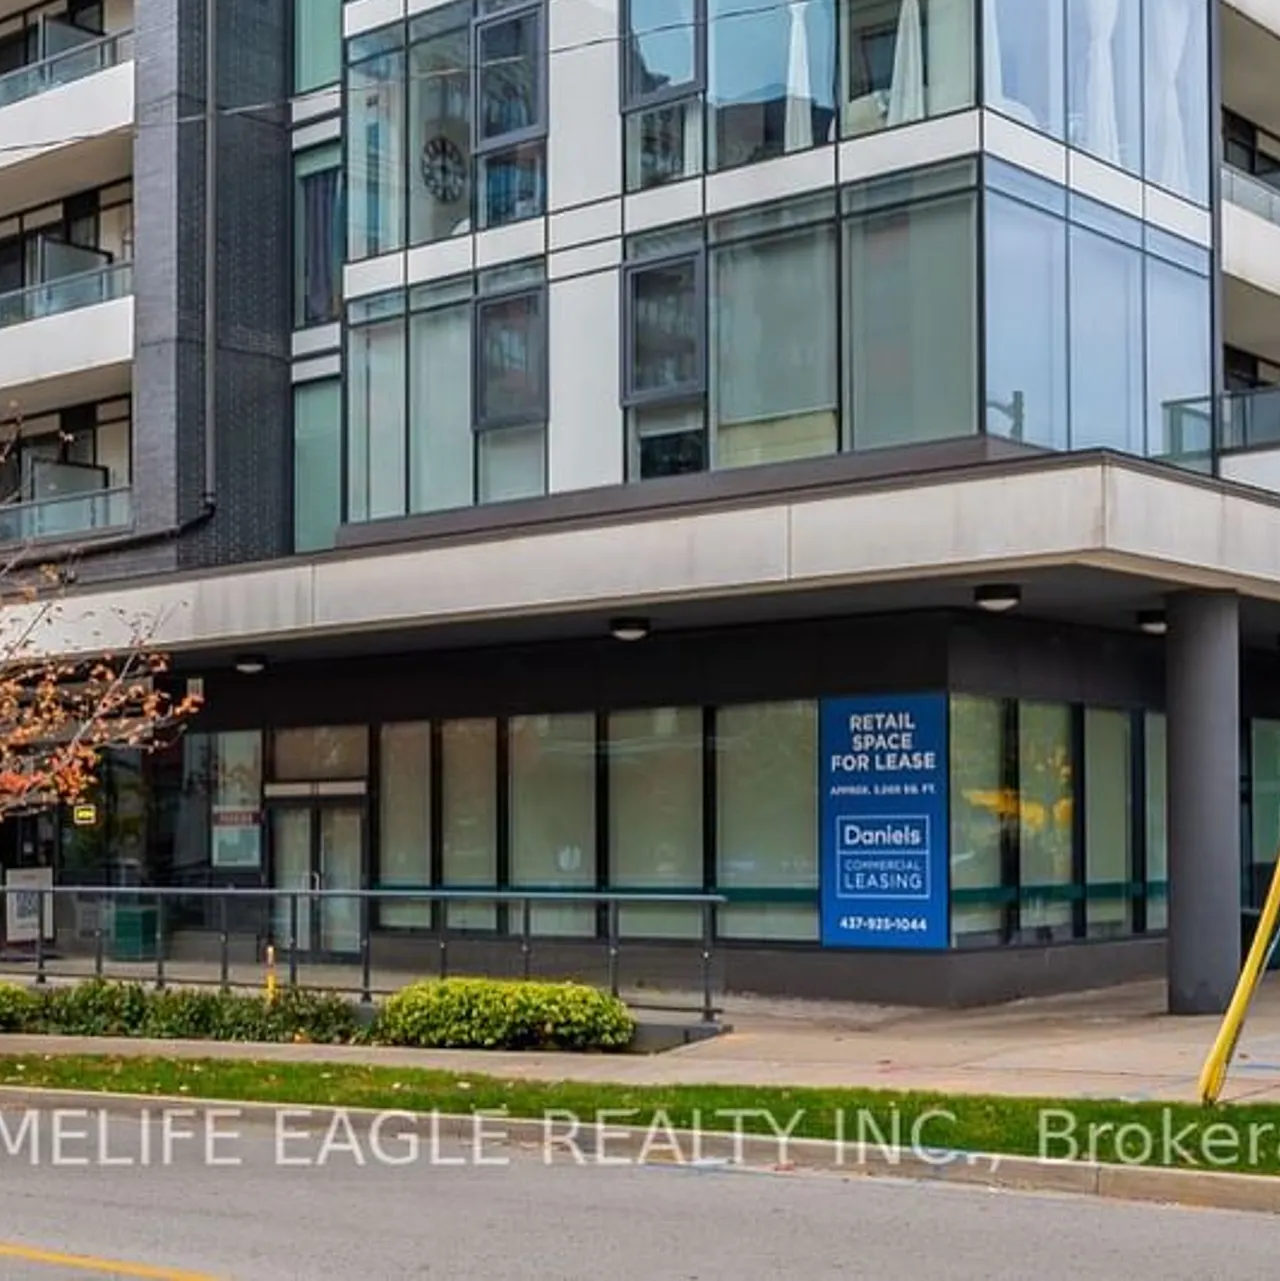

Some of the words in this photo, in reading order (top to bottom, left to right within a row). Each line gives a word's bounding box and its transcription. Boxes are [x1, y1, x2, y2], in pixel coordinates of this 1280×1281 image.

[850, 713, 915, 731] RETAIL
[852, 733, 913, 751] SPACE
[831, 755, 870, 771] FOR
[875, 753, 936, 770] LEASE
[844, 825, 921, 845] Daniels
[844, 860, 920, 871] COMMERCIAL
[844, 873, 922, 889] LEASING
